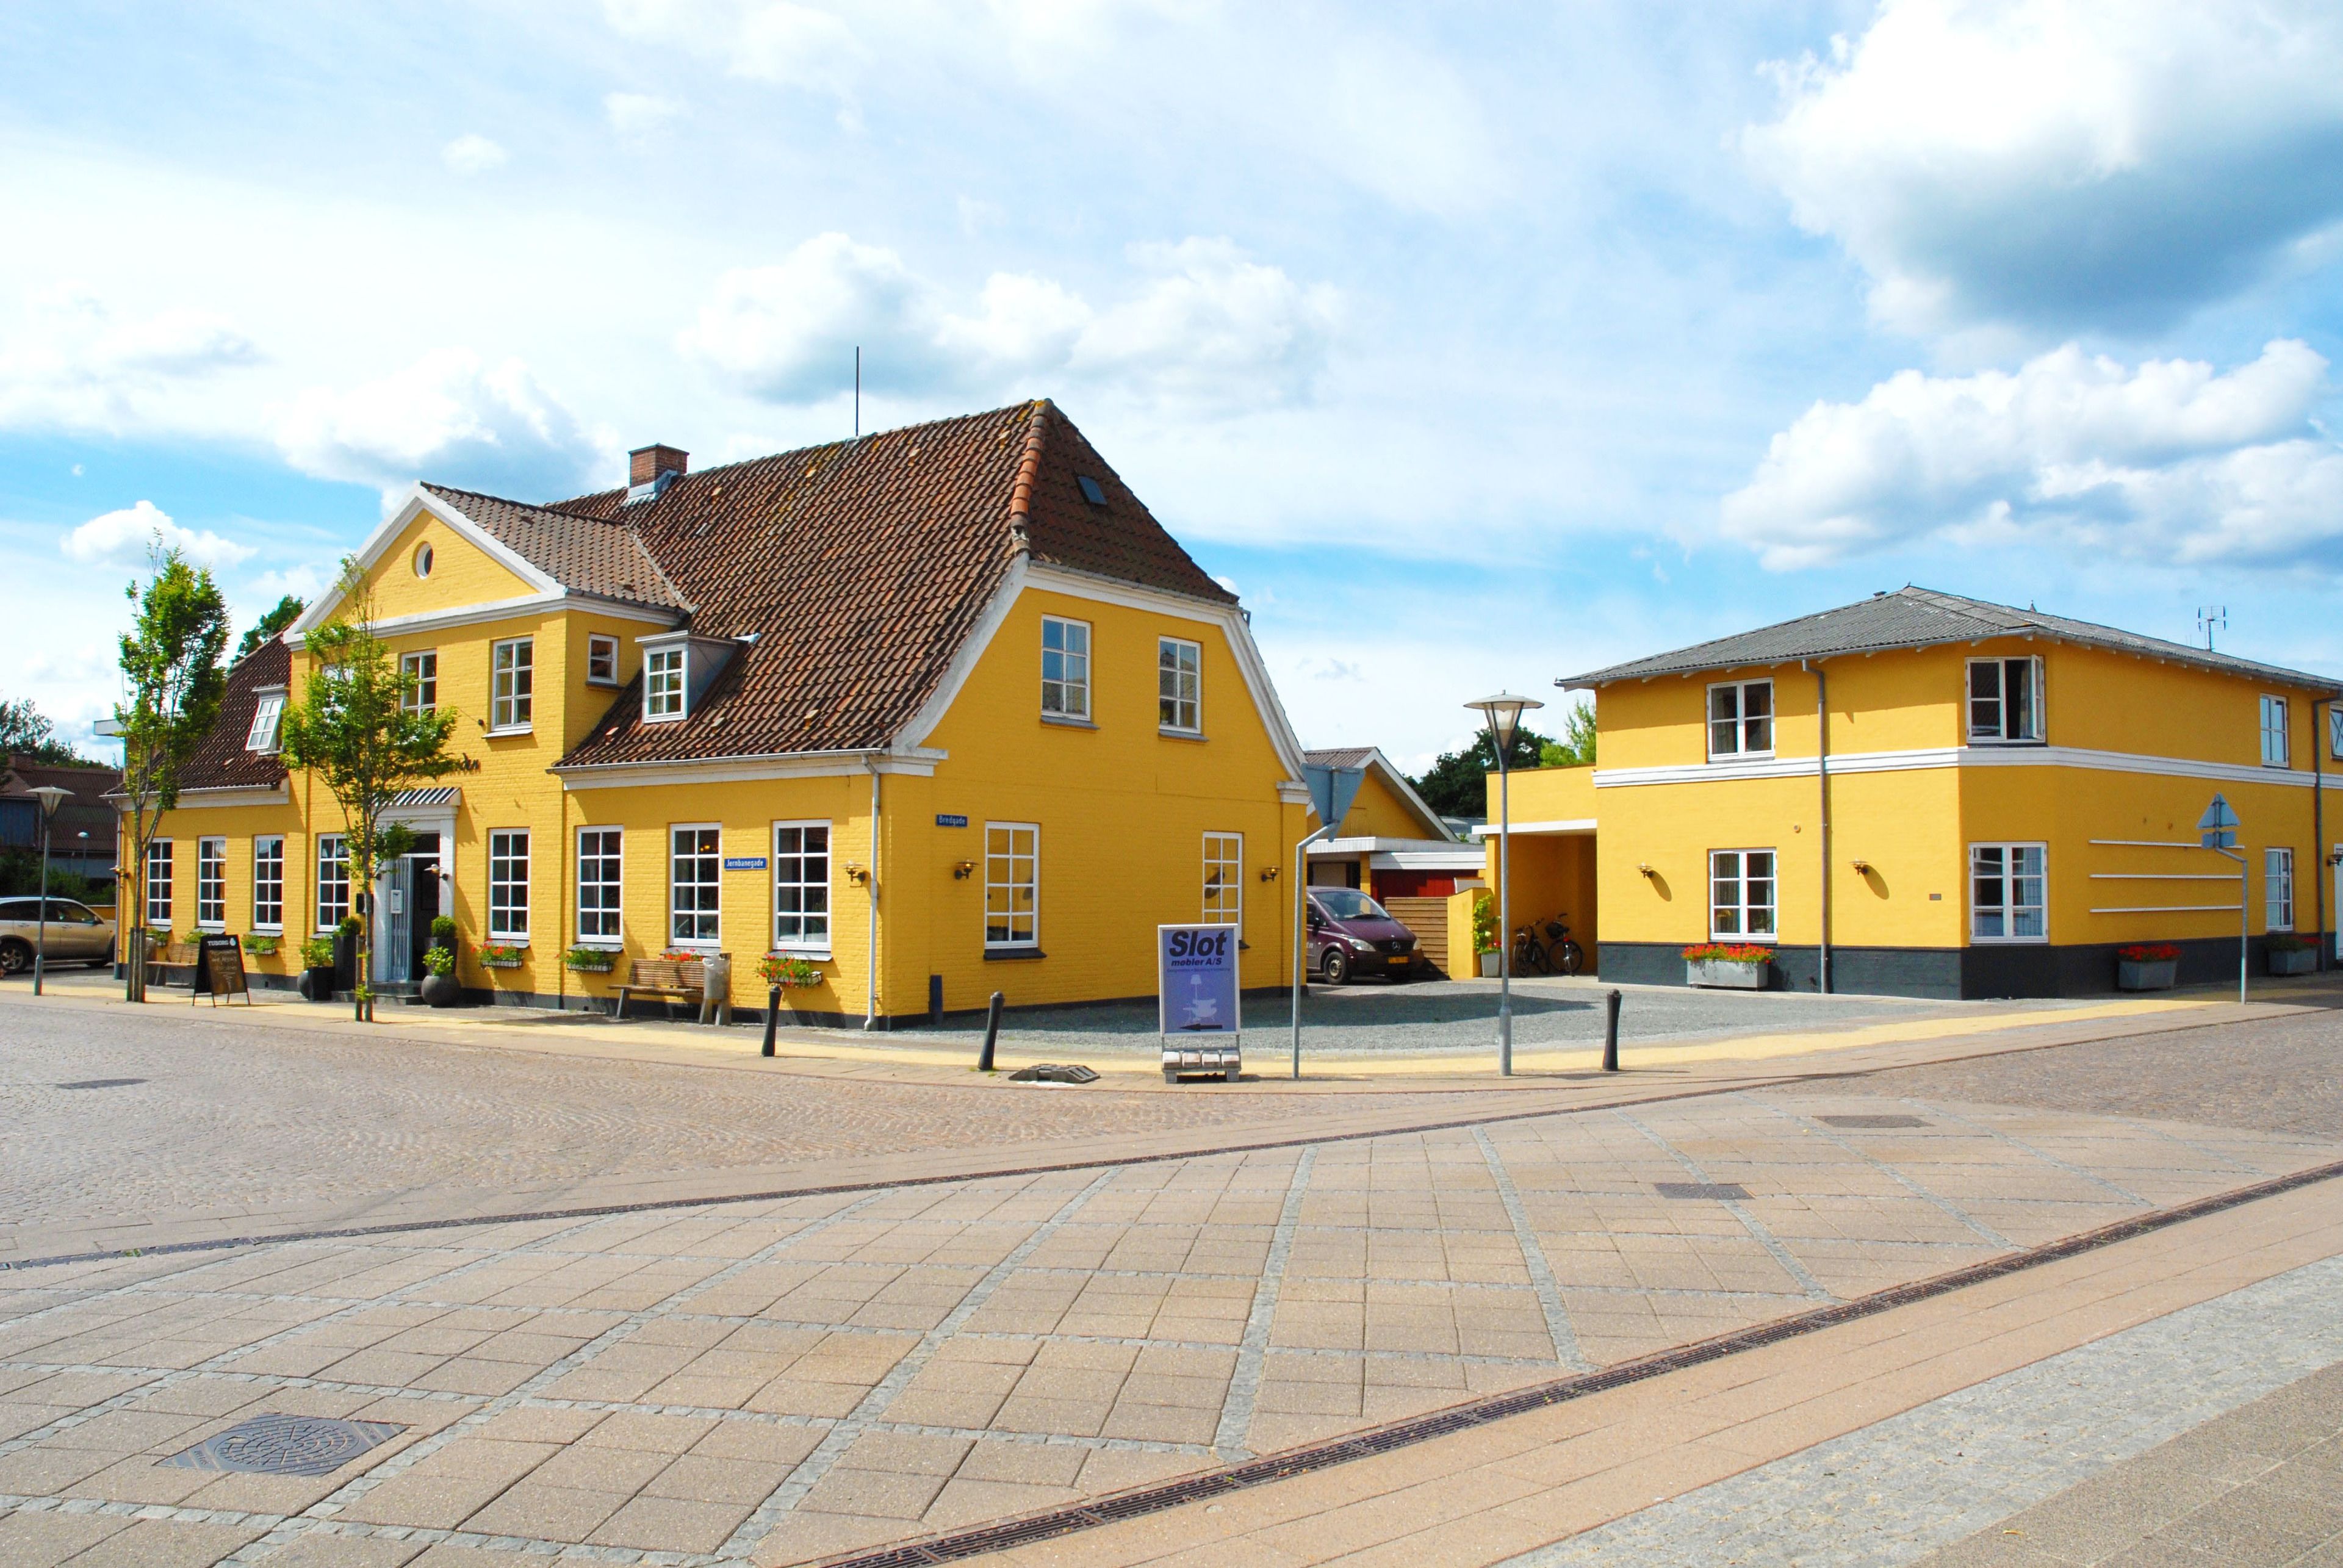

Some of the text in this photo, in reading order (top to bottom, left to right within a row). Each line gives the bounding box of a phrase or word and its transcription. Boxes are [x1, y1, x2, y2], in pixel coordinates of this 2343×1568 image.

[939, 815, 965, 826] Bredgade
[727, 858, 763, 869] Jernbanegade
[1169, 930, 1227, 957] Slot
